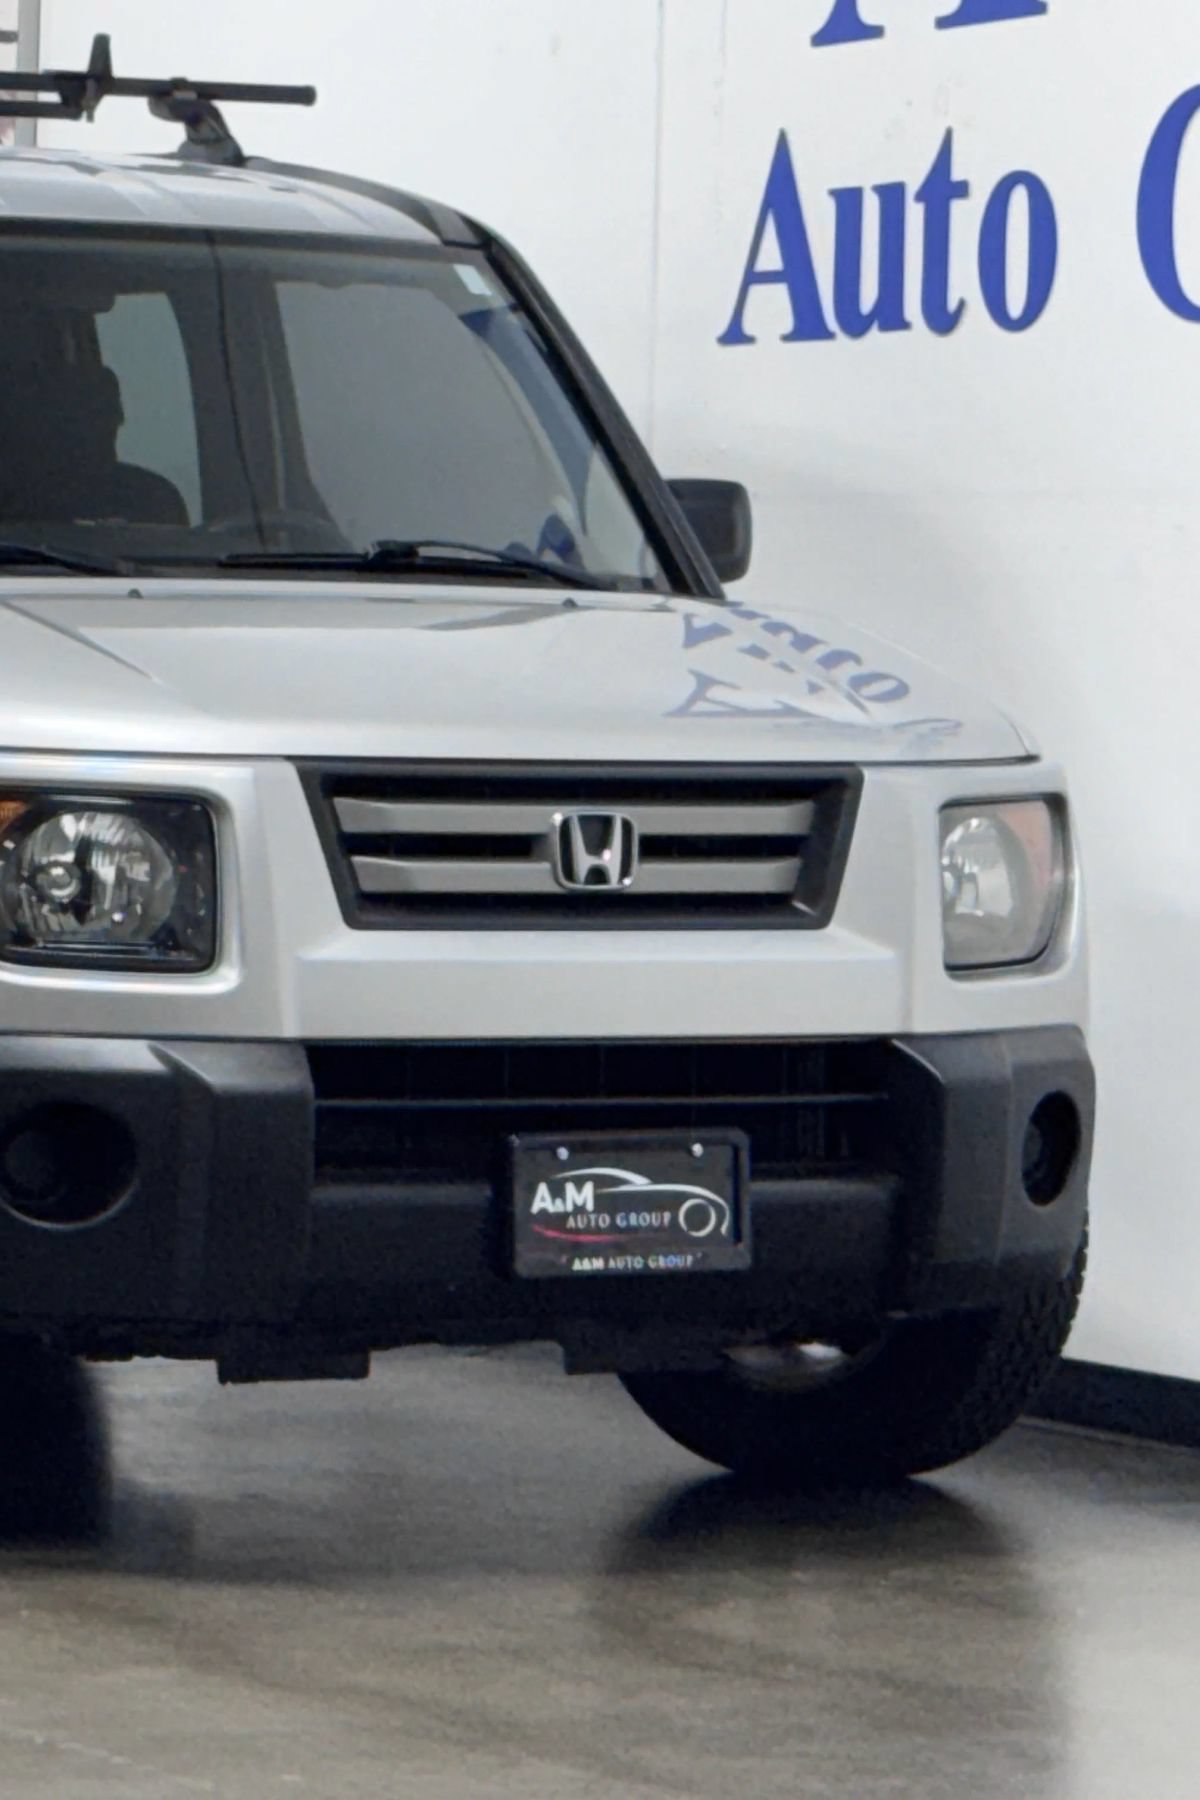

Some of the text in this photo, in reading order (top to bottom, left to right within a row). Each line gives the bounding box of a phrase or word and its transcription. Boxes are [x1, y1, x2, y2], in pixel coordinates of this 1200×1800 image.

[716, 126, 1058, 346] Auto
[566, 1211, 672, 1229] AUTO GROUP
[608, 1256, 644, 1270] AUTO
[647, 1254, 694, 1270] GROUP
